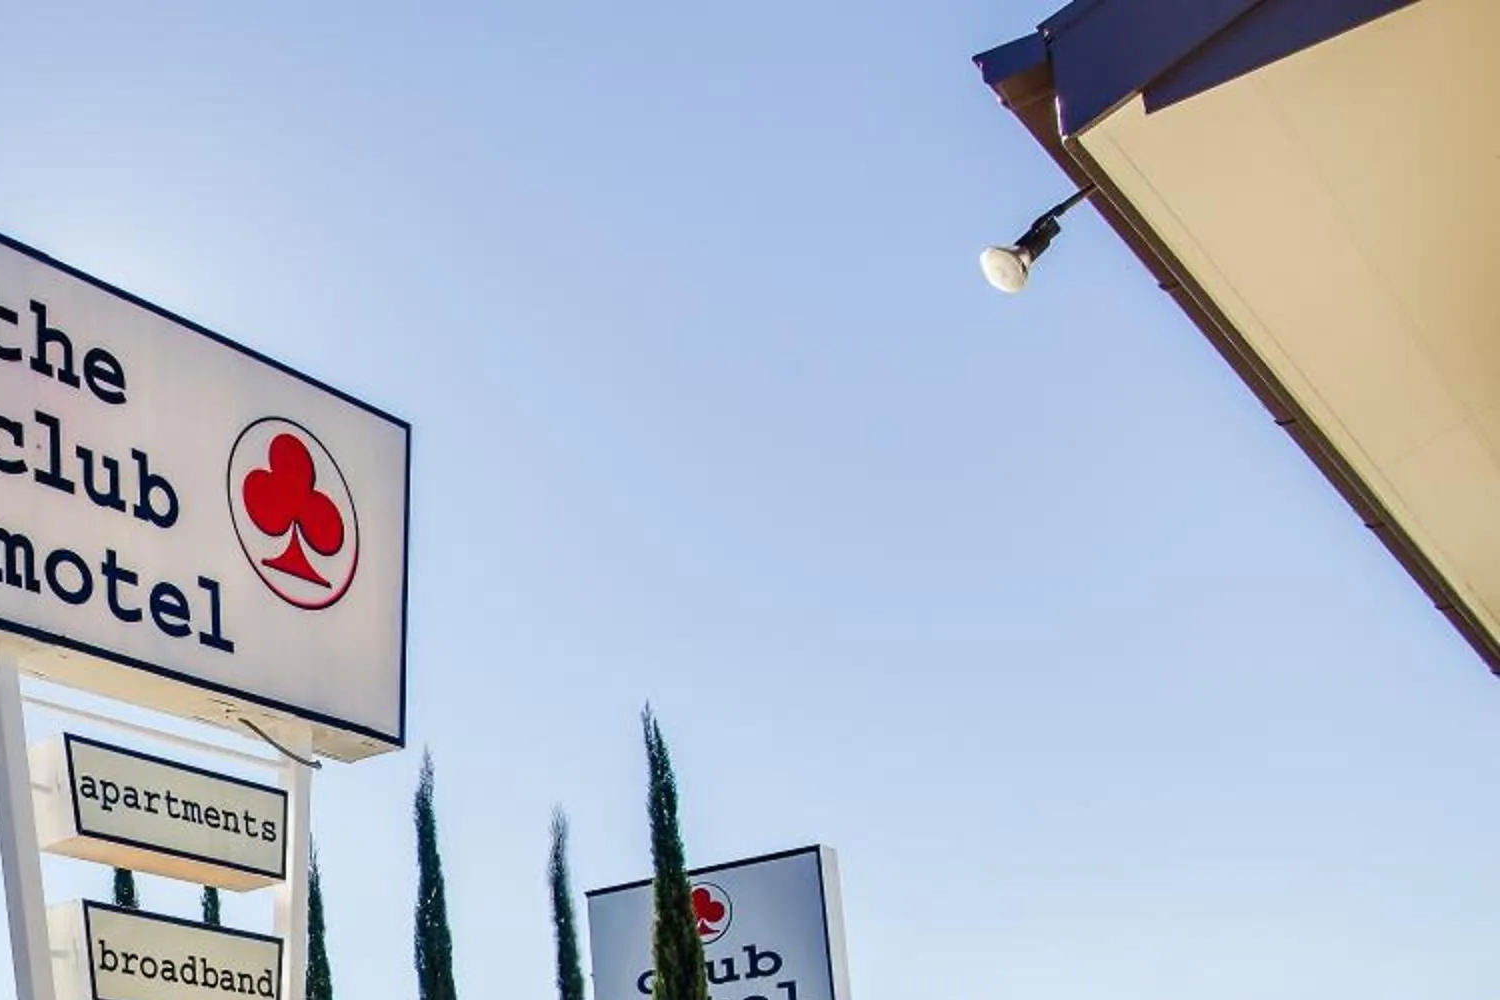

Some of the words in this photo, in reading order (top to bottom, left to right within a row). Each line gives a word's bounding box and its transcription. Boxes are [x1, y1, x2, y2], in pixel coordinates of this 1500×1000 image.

[80, 774, 278, 843] apartments
[97, 939, 276, 999] broadband
[636, 944, 783, 995] cub
